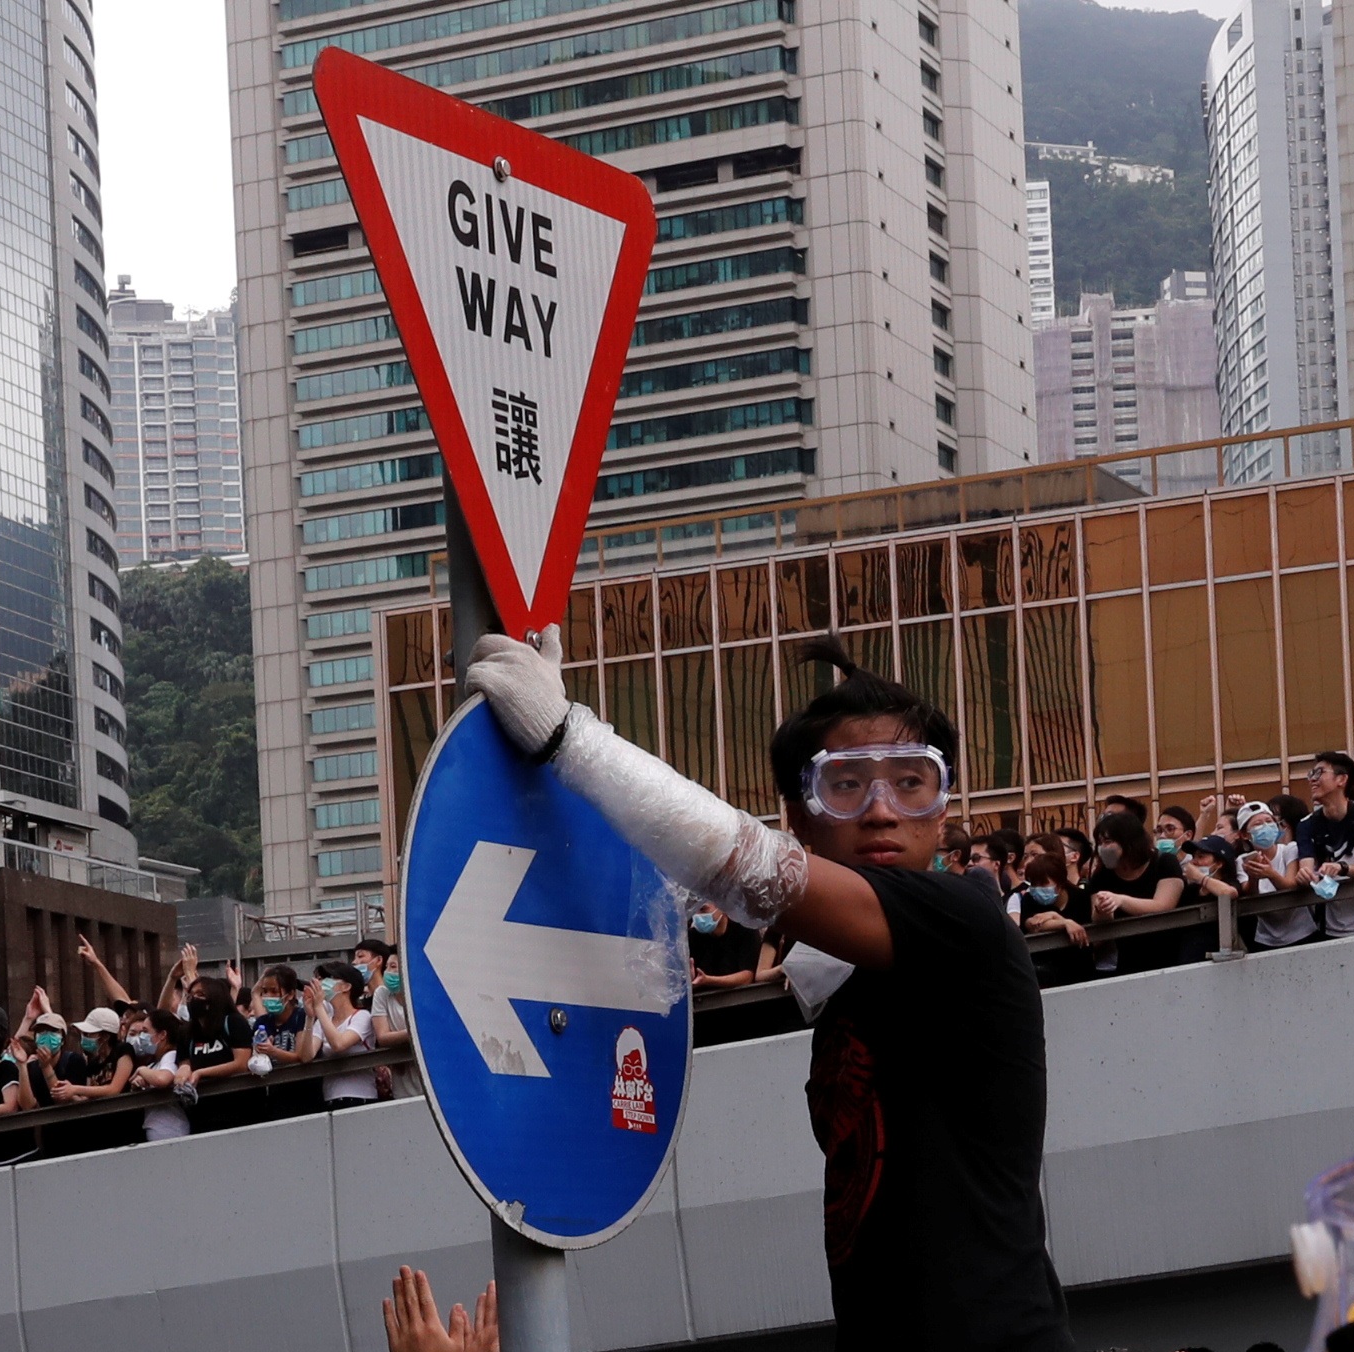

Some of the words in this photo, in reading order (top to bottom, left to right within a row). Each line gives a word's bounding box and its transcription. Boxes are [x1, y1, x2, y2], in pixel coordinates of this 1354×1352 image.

[448, 179, 557, 278] GIVE
[456, 265, 557, 358] WAY
[492, 387, 543, 486] 讓
[194, 1039, 223, 1055] FILA
